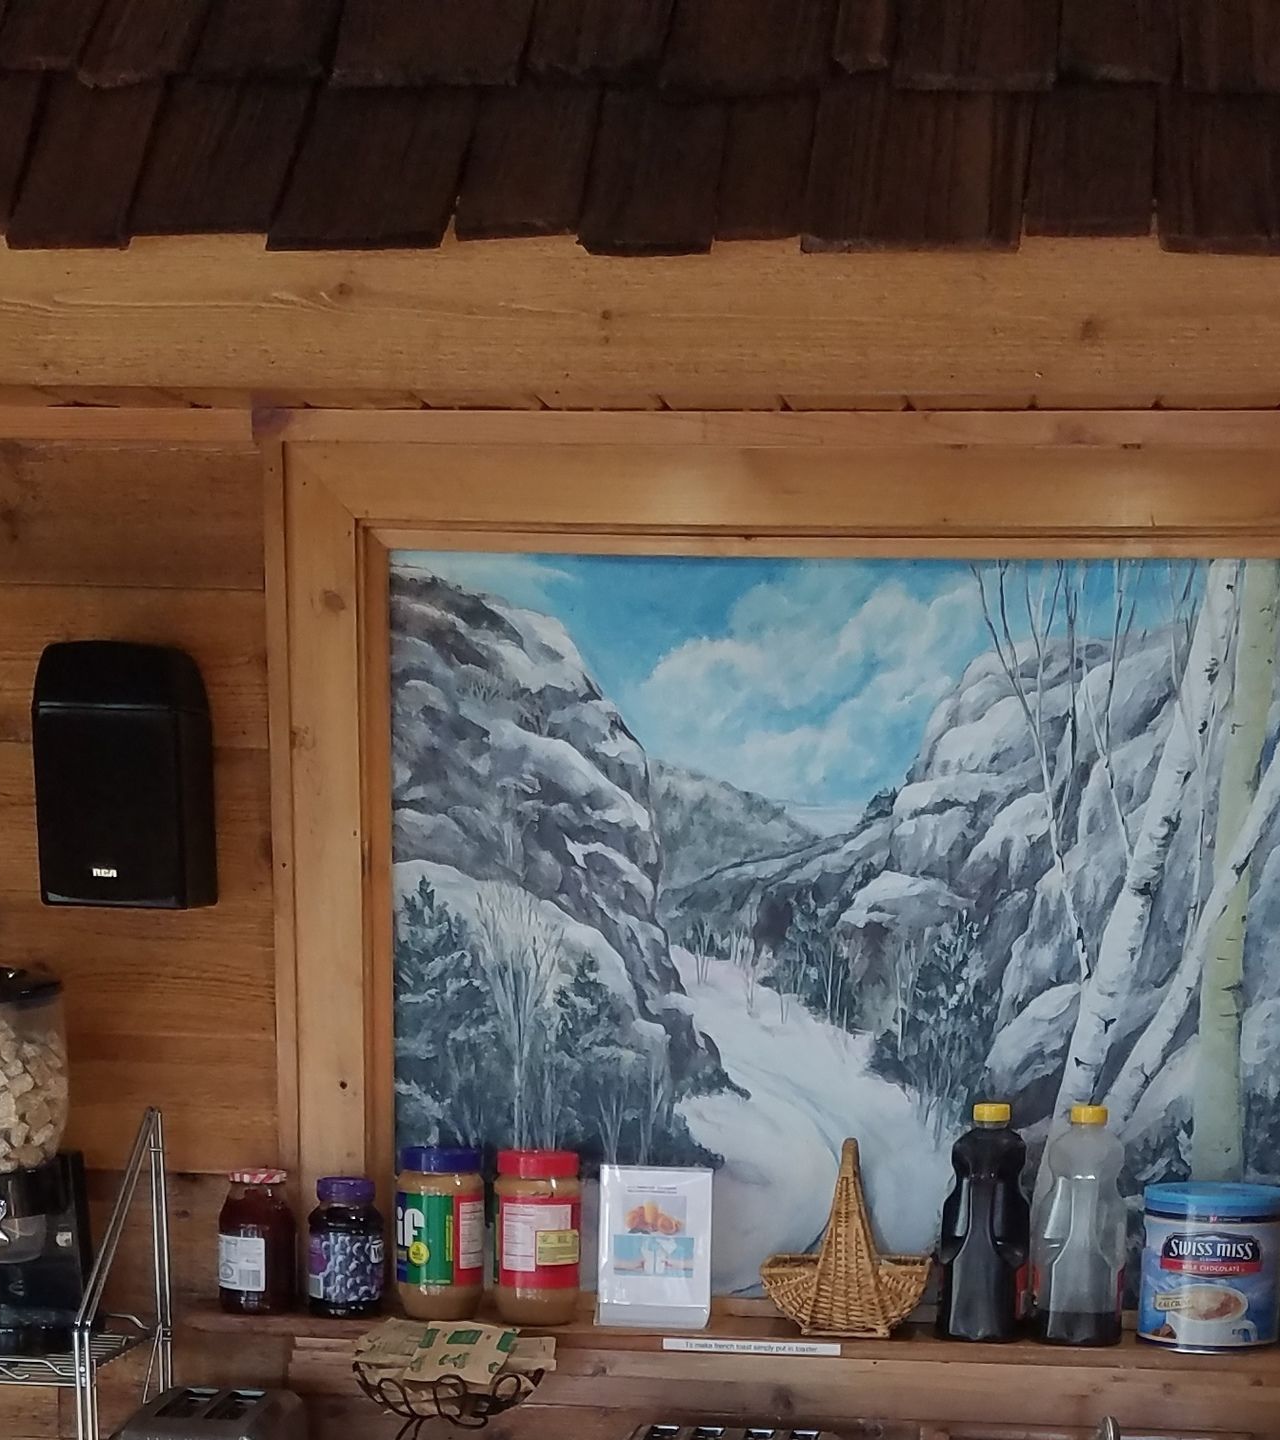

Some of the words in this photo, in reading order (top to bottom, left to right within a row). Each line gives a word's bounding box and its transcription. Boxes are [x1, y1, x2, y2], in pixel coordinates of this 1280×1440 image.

[92, 867, 117, 878] RCA
[396, 1206, 425, 1248] if
[1199, 1264, 1240, 1273] CHOCOLATE
